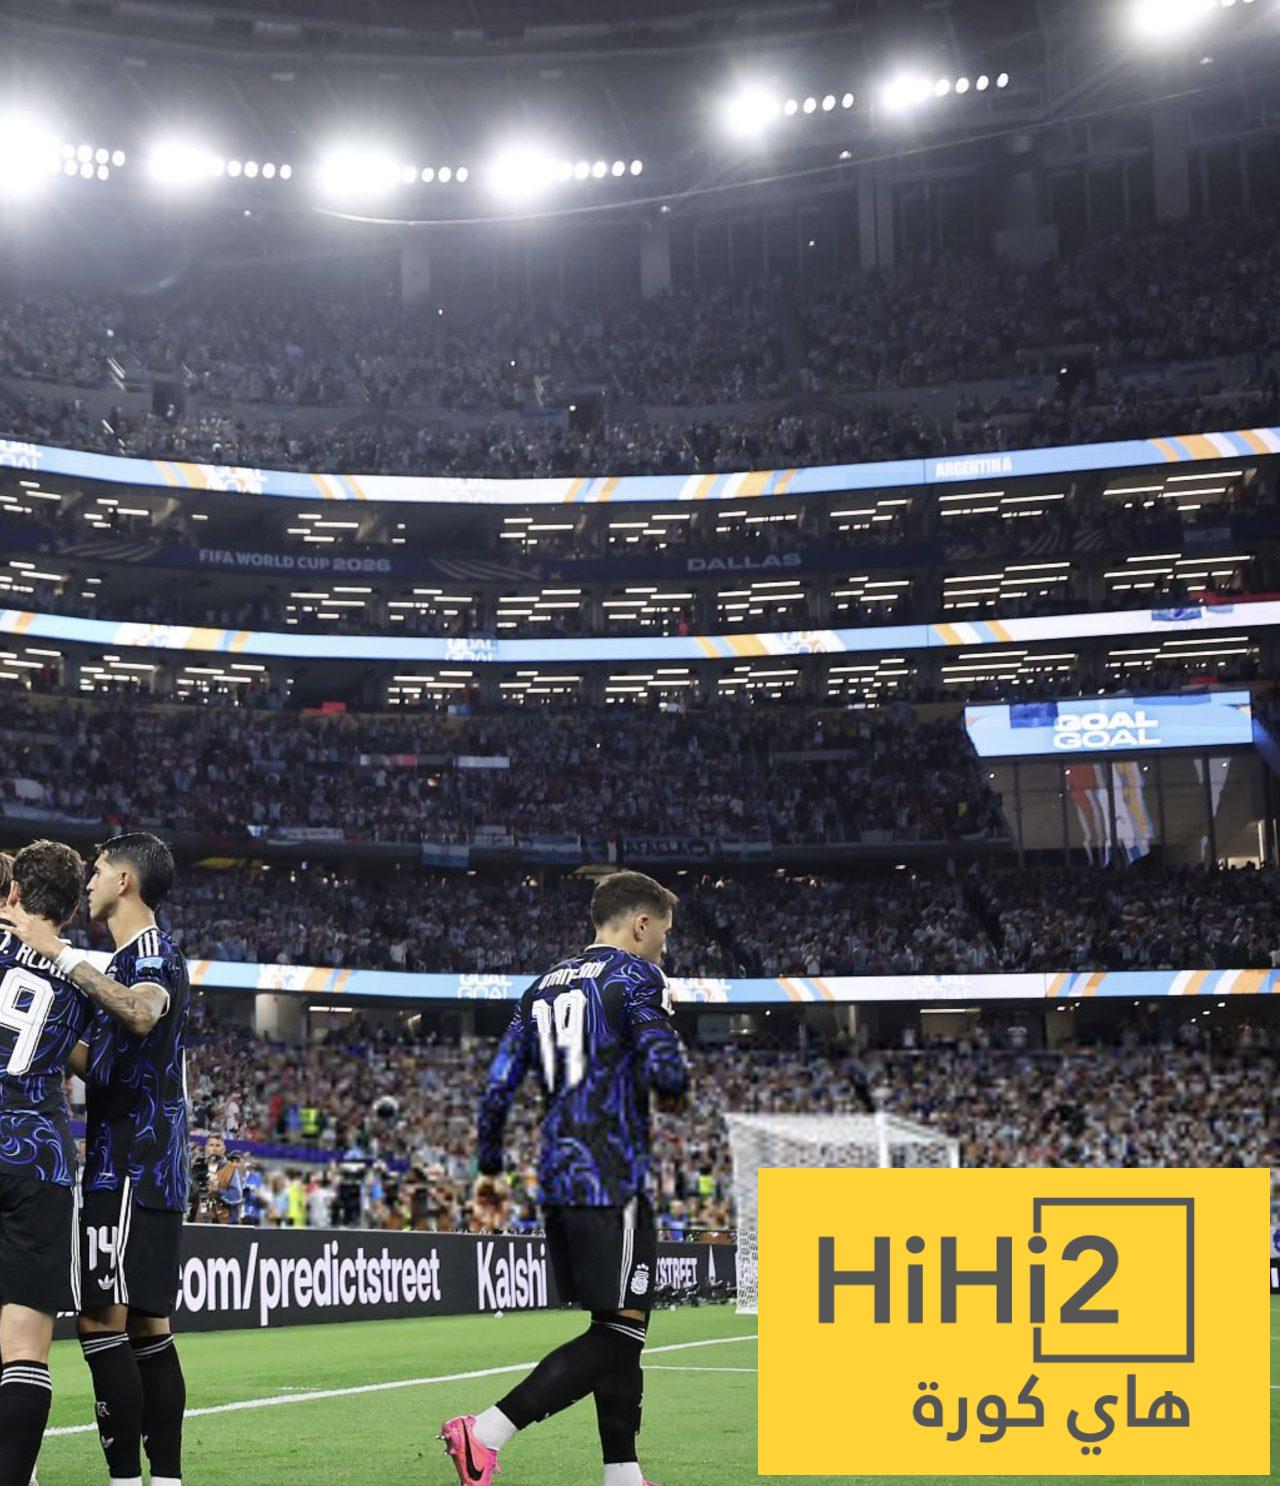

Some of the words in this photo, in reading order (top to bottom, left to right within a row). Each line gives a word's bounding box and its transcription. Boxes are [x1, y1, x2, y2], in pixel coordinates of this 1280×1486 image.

[935, 456, 1013, 478] ARGENTINA
[199, 549, 234, 565] FIFA
[236, 551, 295, 568] WORLD
[297, 556, 330, 570] CUP
[332, 557, 392, 572] 2026
[687, 552, 801, 571] DALLAS
[1053, 710, 1159, 732] GOAL
[1052, 729, 1162, 749] GOAL
[532, 989, 588, 1093] 19
[86, 1226, 118, 1271] 14
[477, 1241, 548, 1310] Kalshi
